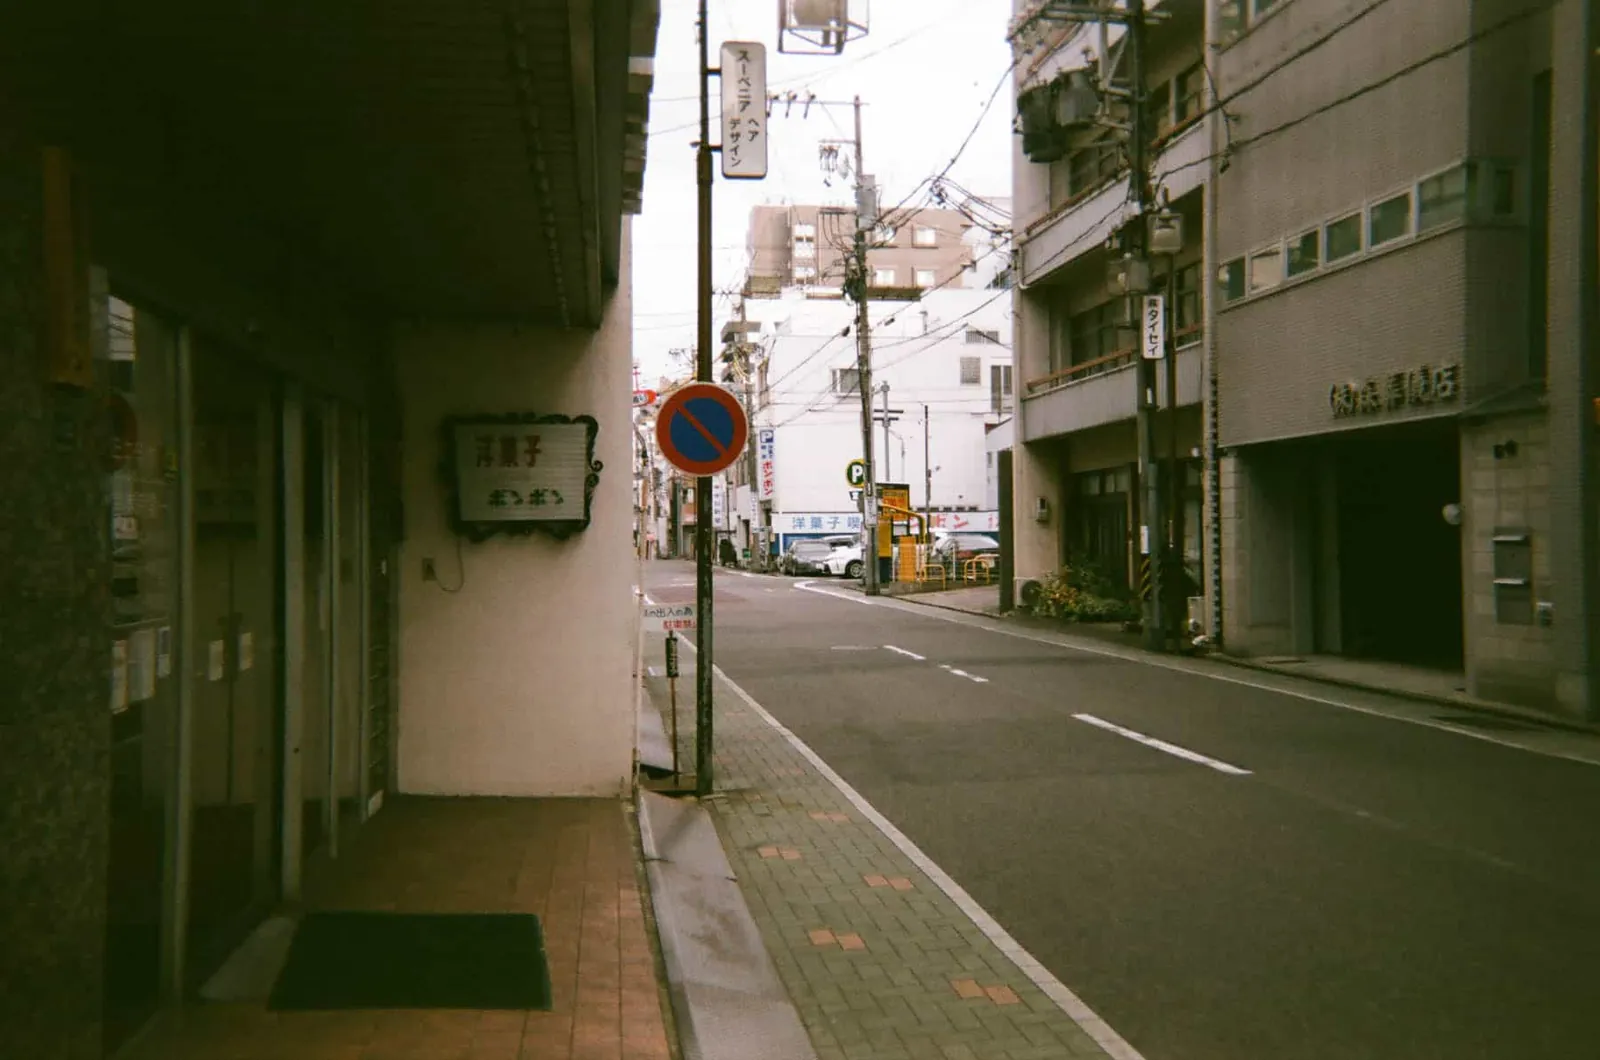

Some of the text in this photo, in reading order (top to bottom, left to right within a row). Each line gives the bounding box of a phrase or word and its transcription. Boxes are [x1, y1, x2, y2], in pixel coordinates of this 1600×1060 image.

[736, 50, 751, 113] スーベニア
[729, 118, 742, 168] デザイン
[747, 118, 760, 142] ヘア
[852, 465, 863, 483] P
